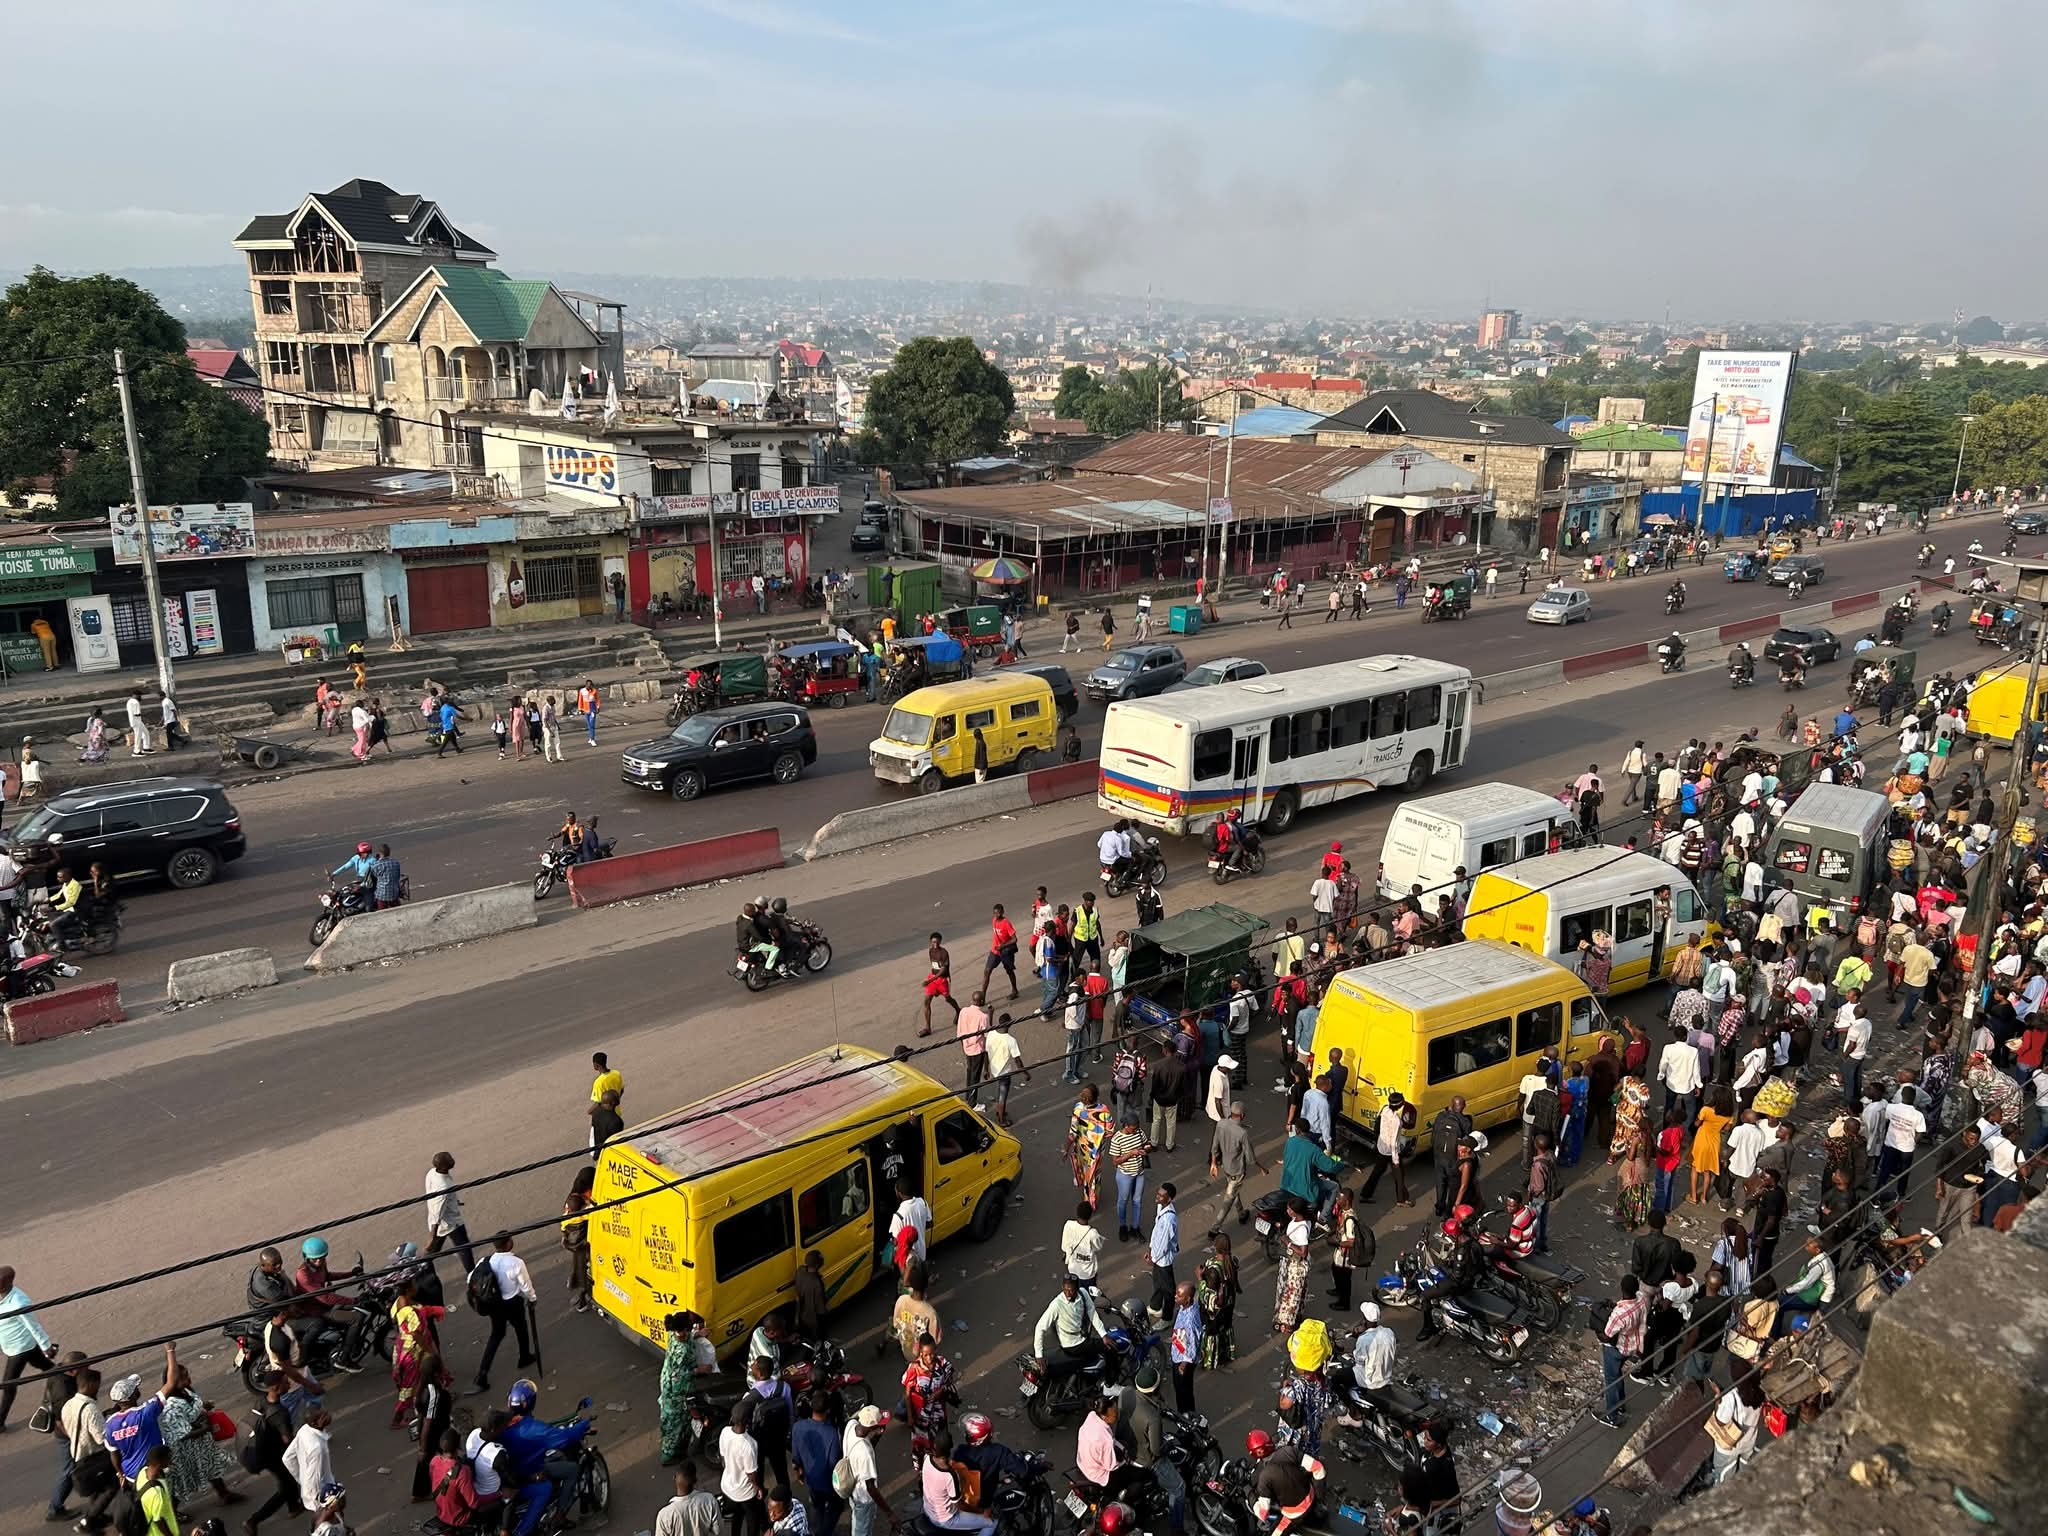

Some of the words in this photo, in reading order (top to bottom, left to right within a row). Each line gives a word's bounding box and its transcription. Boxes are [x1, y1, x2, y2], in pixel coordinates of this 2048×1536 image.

[1732, 359, 1781, 367] NUMEROTATION
[547, 446, 615, 491] UDPS
[751, 490, 781, 501] CLINIQUE
[784, 488, 794, 499] DE
[752, 499, 795, 513] BELLE
[796, 496, 839, 509] CAMPUS
[258, 535, 304, 552] SAMBA
[0, 559, 34, 575] TOISIE
[40, 556, 76, 571] TUMBA
[1373, 750, 1400, 763] TRANSCO
[1405, 816, 1443, 832] manager
[659, 1225, 667, 1238] NE
[651, 1291, 679, 1306] 312
[639, 1313, 666, 1330] MERCED
